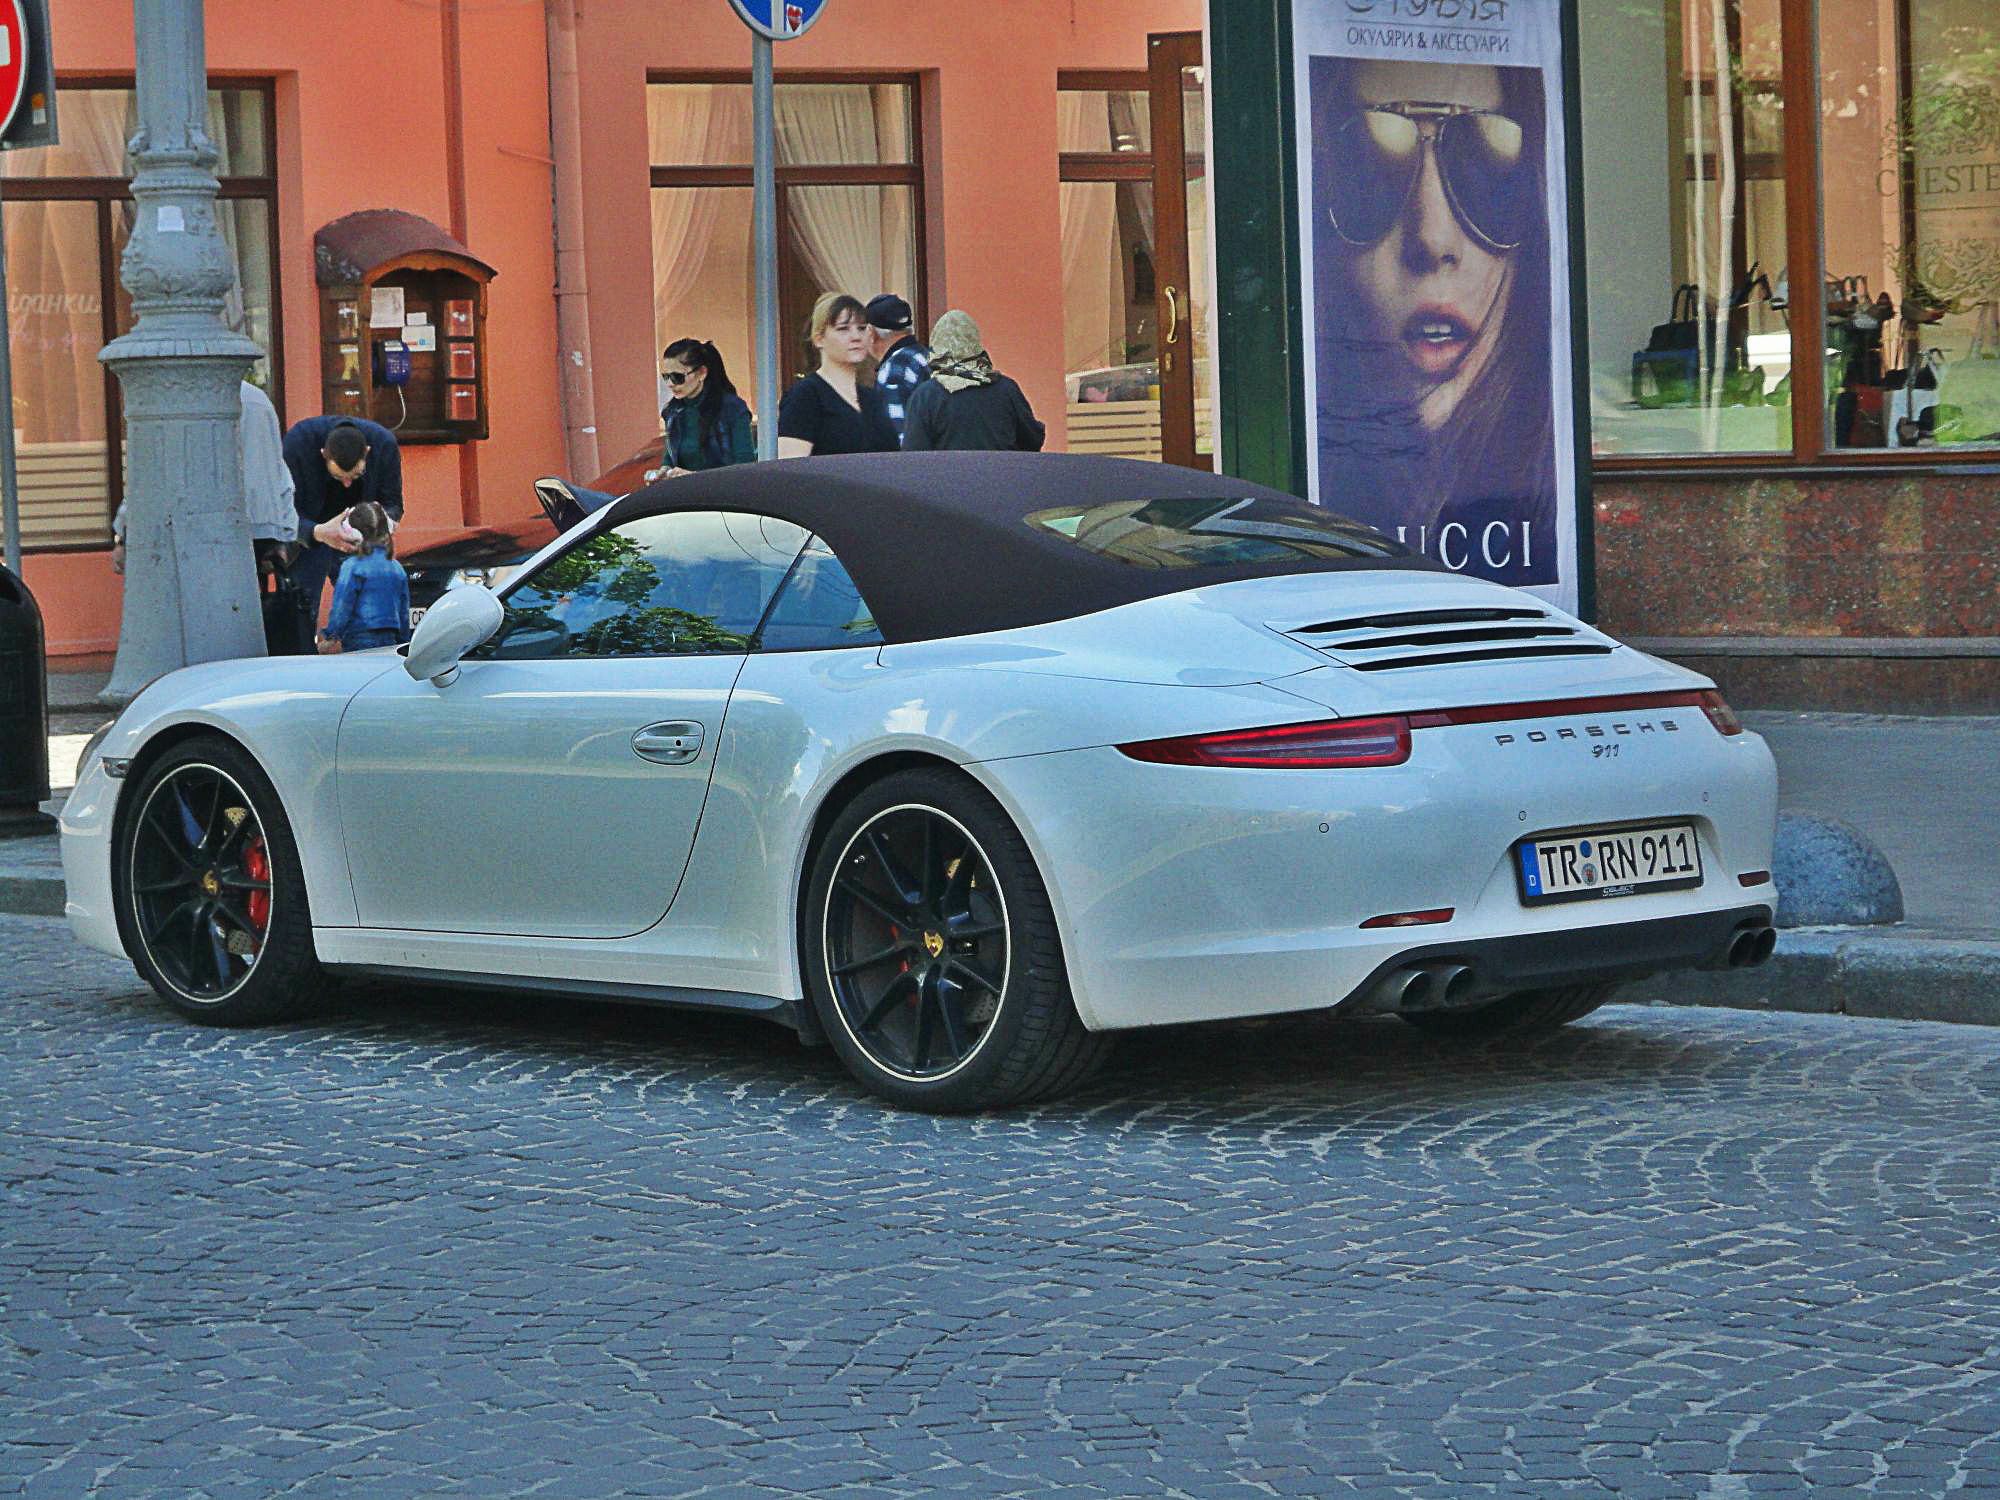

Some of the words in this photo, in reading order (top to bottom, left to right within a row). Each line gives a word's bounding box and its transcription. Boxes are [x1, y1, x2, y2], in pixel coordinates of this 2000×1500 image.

[1347, 26, 1414, 48] ОКУЛЯРИ
[1418, 32, 1427, 48] &
[1431, 32, 1510, 52] АКСЕСУАРИ
[8, 288, 99, 324] іданки
[1370, 520, 1532, 570] CCI
[1494, 720, 1679, 747] PORSCHE
[1591, 744, 1620, 758] 911
[1529, 874, 1537, 887] D
[1539, 844, 1582, 886] TR
[1598, 838, 1638, 881] RN
[1641, 832, 1695, 876] 911
